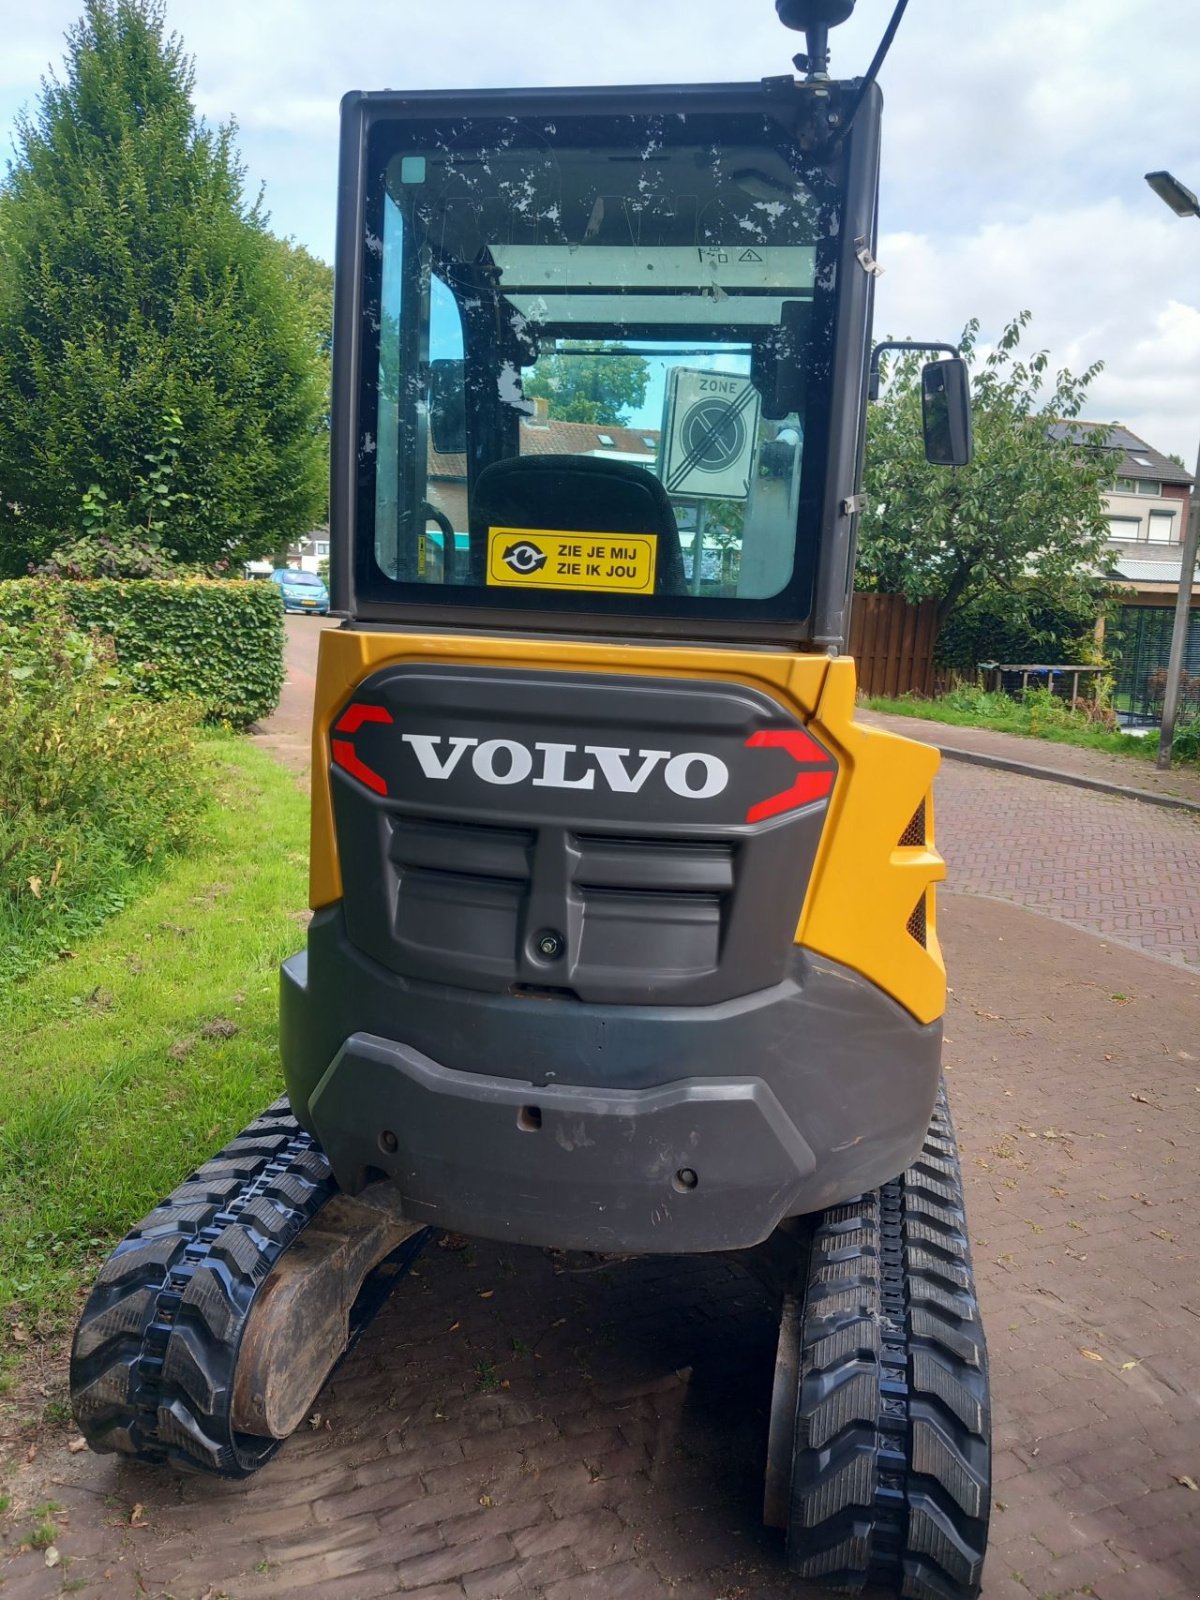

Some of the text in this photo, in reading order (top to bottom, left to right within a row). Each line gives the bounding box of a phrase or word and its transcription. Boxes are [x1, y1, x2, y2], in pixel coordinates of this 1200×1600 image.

[699, 379, 737, 394] ZONE
[557, 544, 637, 561] ZIE JE MIJ
[556, 562, 637, 579] ZIE IK JOU
[401, 733, 729, 799] VOLVO
